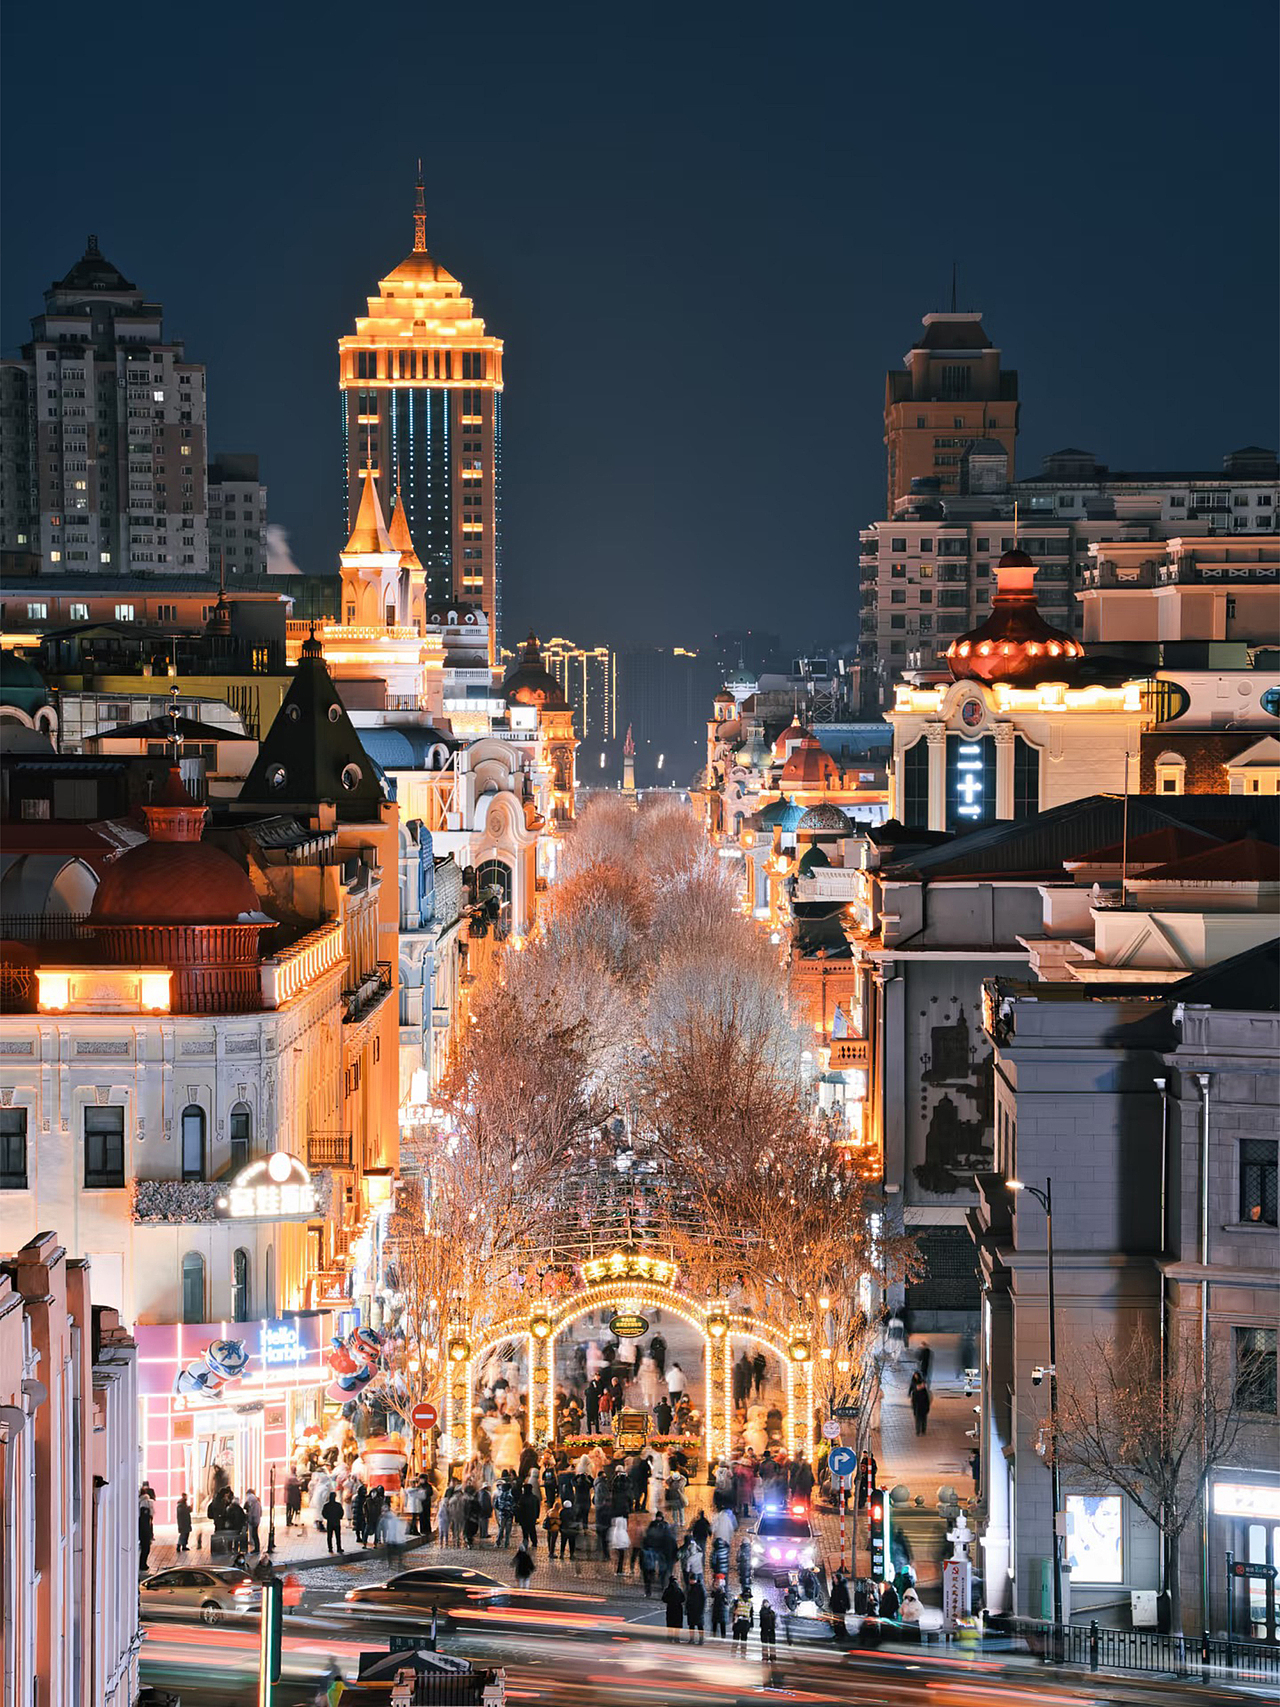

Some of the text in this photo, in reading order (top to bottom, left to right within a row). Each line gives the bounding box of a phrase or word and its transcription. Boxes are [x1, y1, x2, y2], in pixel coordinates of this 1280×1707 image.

[586, 1258, 674, 1284] 中央大街
[260, 1327, 296, 1344] Hello
[261, 1343, 306, 1362] Harbin
